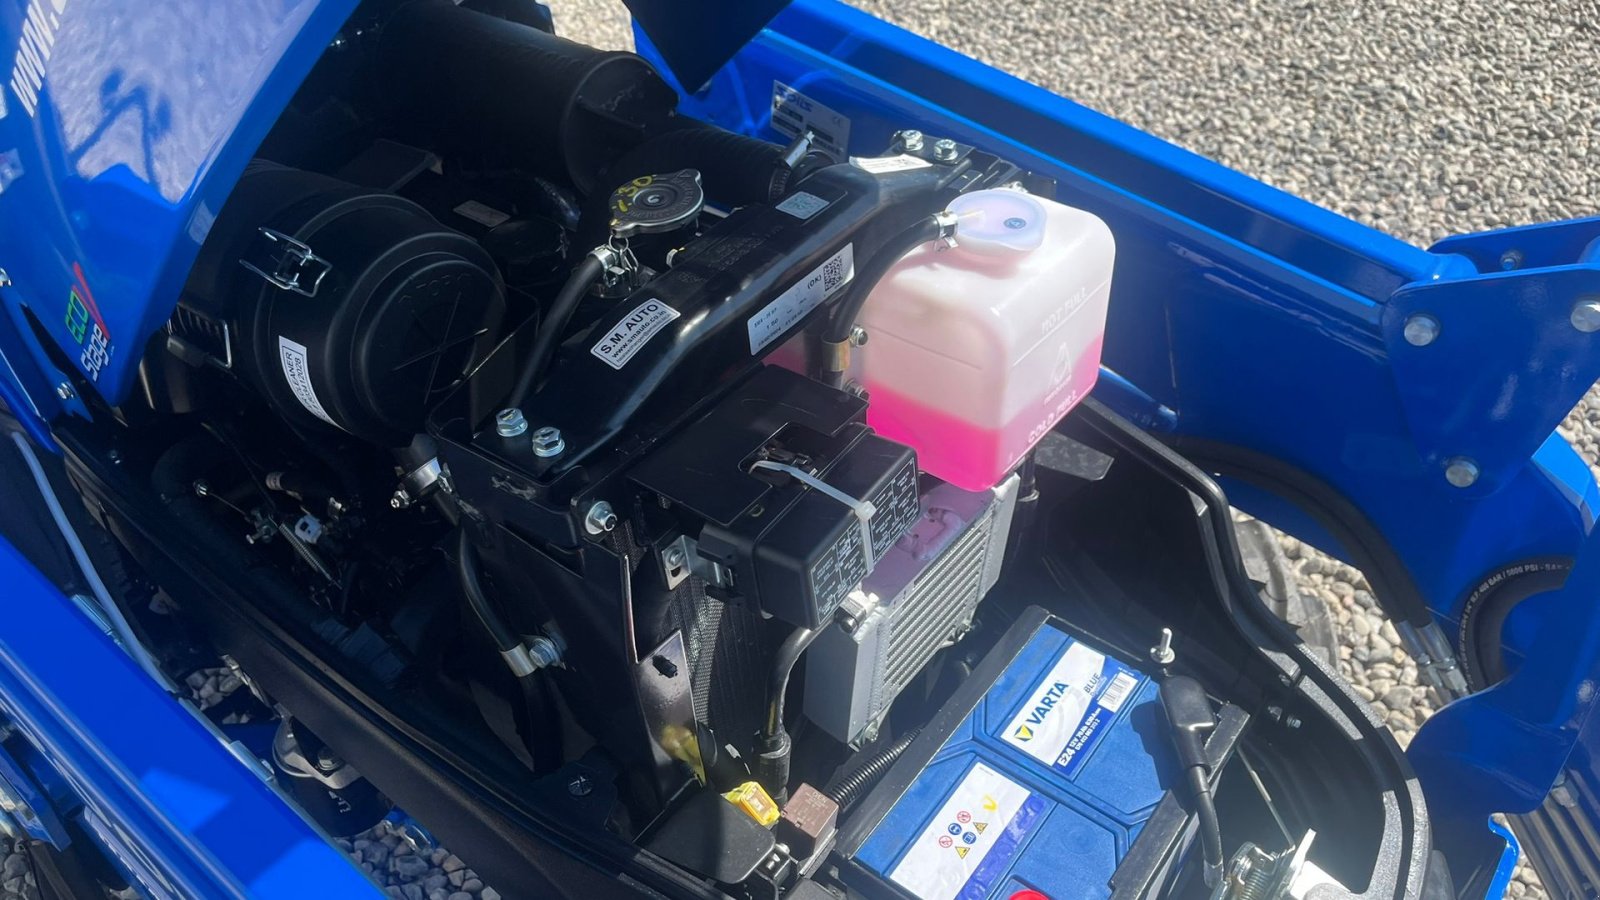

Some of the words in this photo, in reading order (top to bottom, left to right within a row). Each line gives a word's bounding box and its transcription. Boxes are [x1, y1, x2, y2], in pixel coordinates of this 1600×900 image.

[65, 290, 89, 345] ECO
[600, 332, 628, 355] S.M.
[625, 303, 659, 332] AUTO
[81, 323, 109, 382] Stage
[1488, 573, 1503, 586] BAR
[1525, 564, 1538, 572] PSI
[1026, 680, 1069, 725] VARTA
[1085, 672, 1100, 694] BLUE
[1057, 744, 1076, 767] E24
